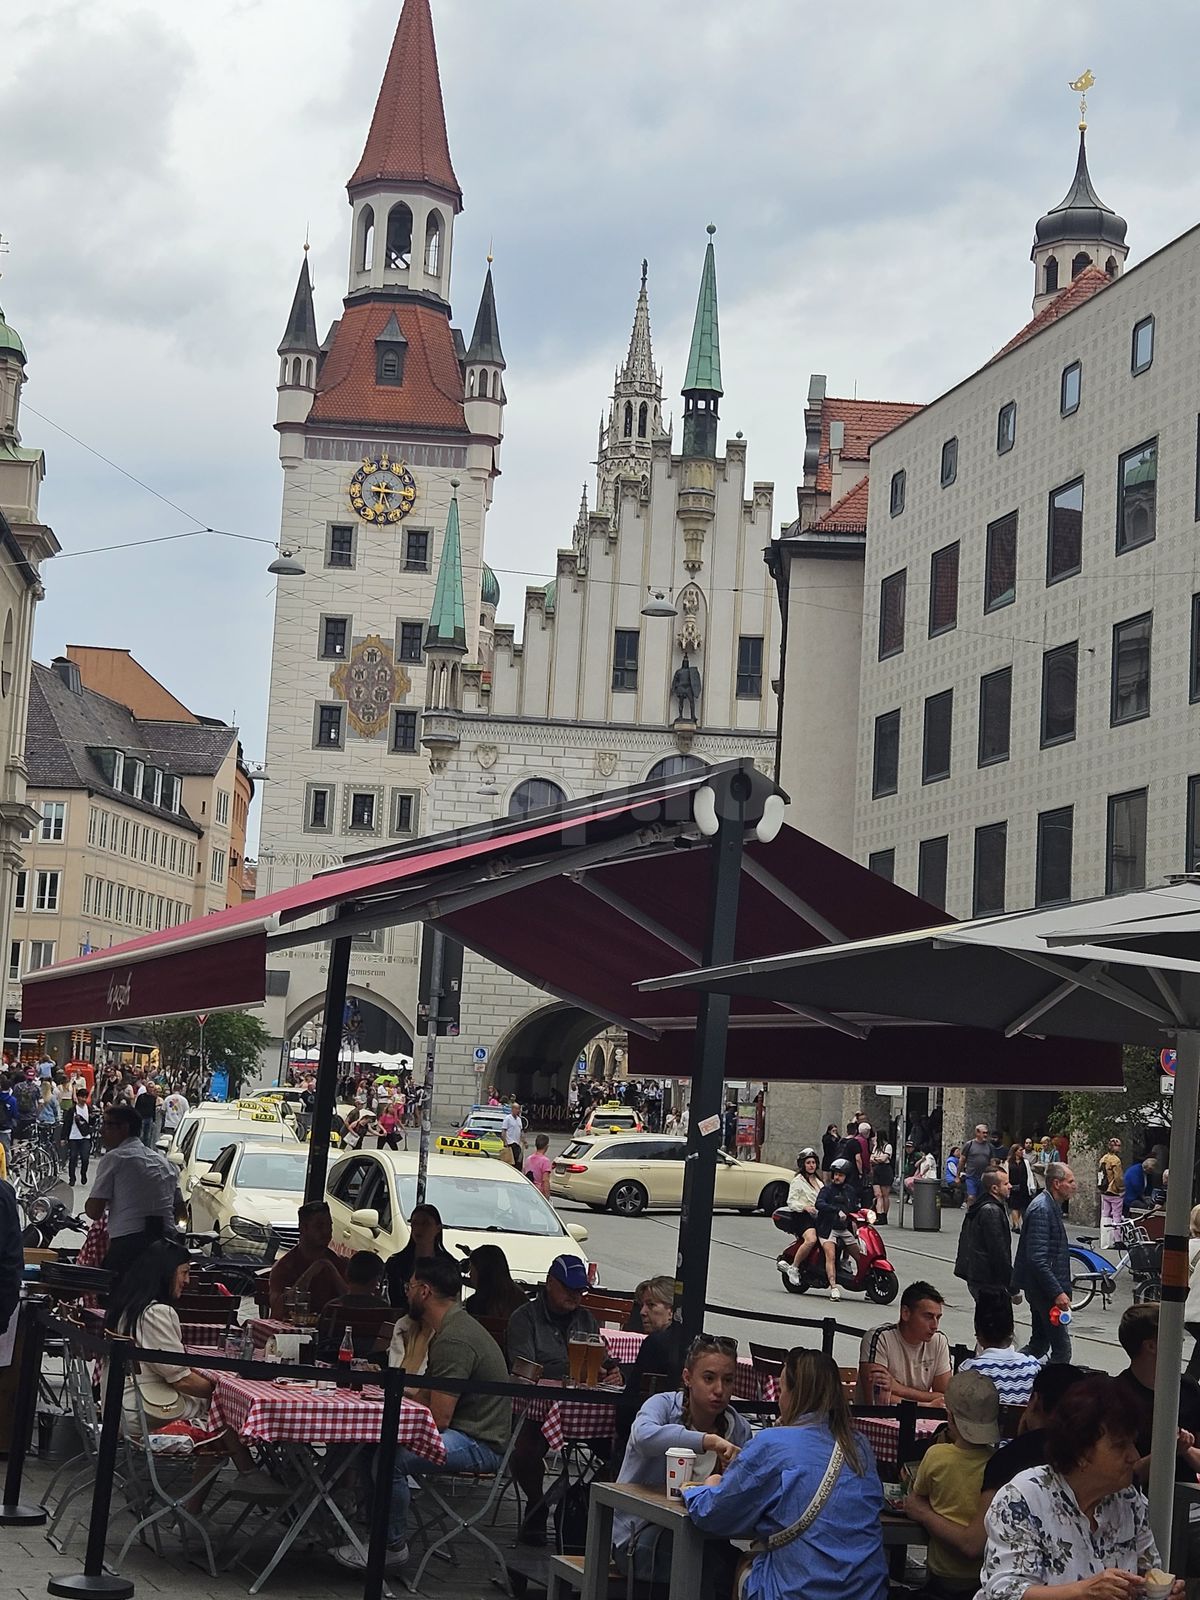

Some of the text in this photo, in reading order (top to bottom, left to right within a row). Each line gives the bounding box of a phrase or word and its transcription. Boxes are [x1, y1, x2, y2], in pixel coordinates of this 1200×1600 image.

[579, 1054, 586, 1062] S
[579, 1062, 586, 1070] U
[256, 1113, 275, 1121] TAXI
[445, 1138, 476, 1149] TAXI
[819, 1472, 835, 1499] GUESS
